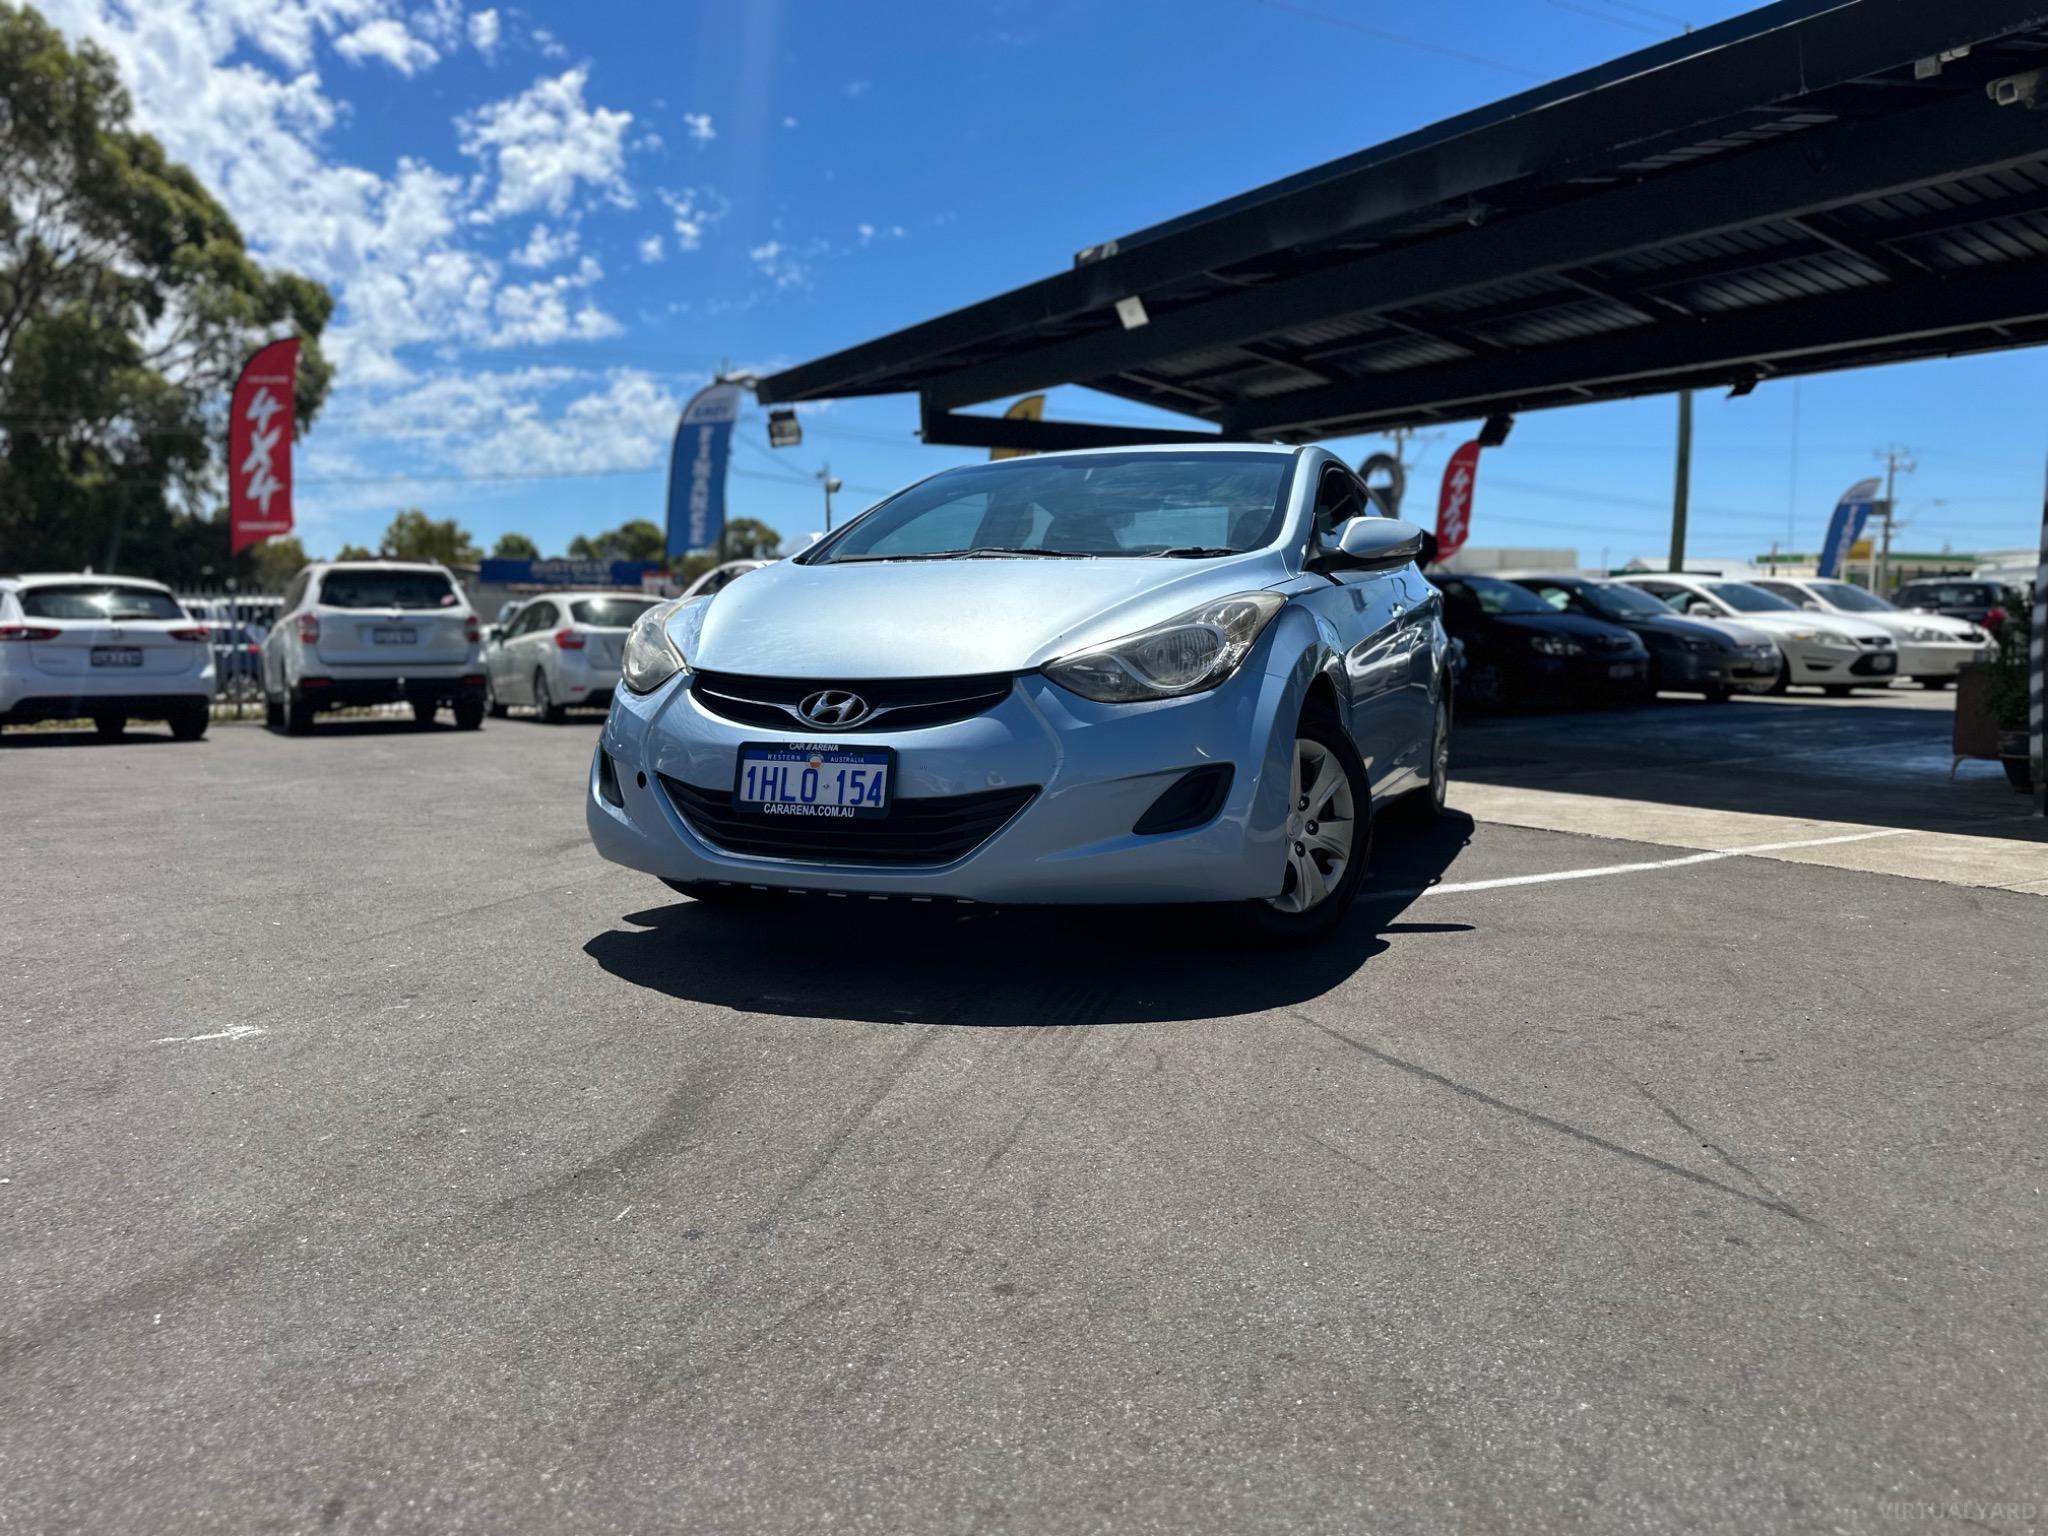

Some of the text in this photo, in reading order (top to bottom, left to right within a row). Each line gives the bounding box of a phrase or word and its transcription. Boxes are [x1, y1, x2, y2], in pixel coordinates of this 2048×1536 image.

[747, 766, 883, 806] 1HLO 154
[763, 803, 855, 818] CARARENA.COM.AU
